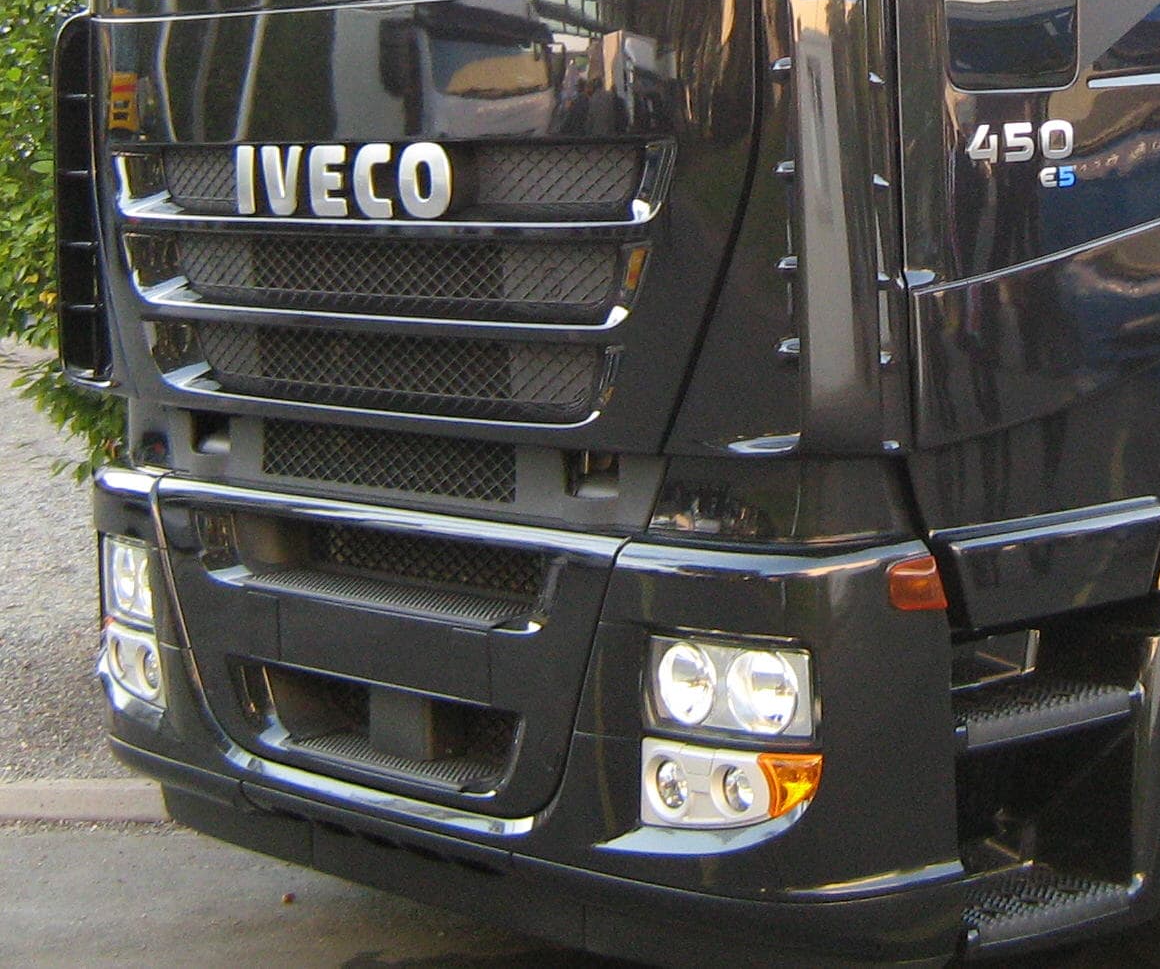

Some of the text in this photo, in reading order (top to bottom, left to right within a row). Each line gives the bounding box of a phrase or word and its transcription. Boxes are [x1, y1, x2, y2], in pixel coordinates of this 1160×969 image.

[965, 118, 1074, 164] 450
[235, 142, 453, 219] IVECO
[1039, 165, 1077, 189] E5
